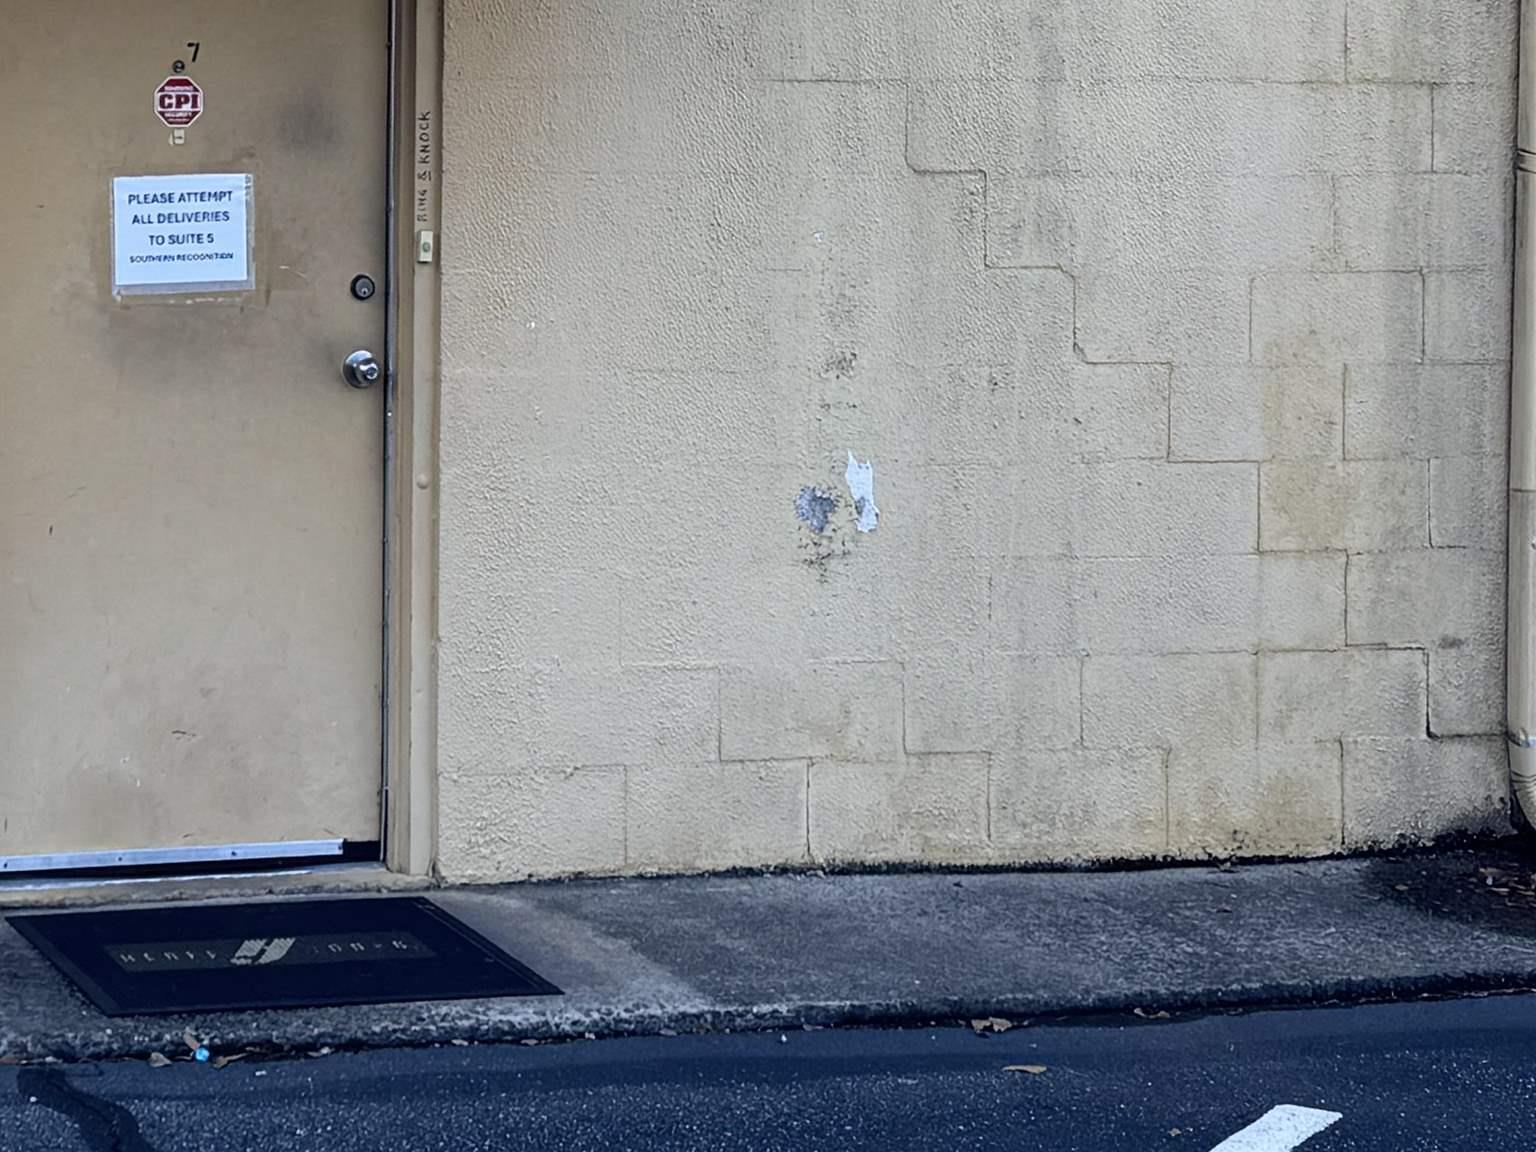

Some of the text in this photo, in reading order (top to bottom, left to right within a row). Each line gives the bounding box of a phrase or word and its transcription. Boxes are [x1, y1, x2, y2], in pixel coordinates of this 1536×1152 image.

[187, 42, 200, 62] 7
[159, 93, 200, 109] CPI
[418, 111, 431, 164] KNOCK
[128, 191, 233, 205] PLEASE ATTEMPT
[132, 211, 230, 225] ALL DELIVERIES
[148, 233, 215, 246] TO SUITE 5
[129, 252, 234, 263] SOUTHERN RECOGNITION
